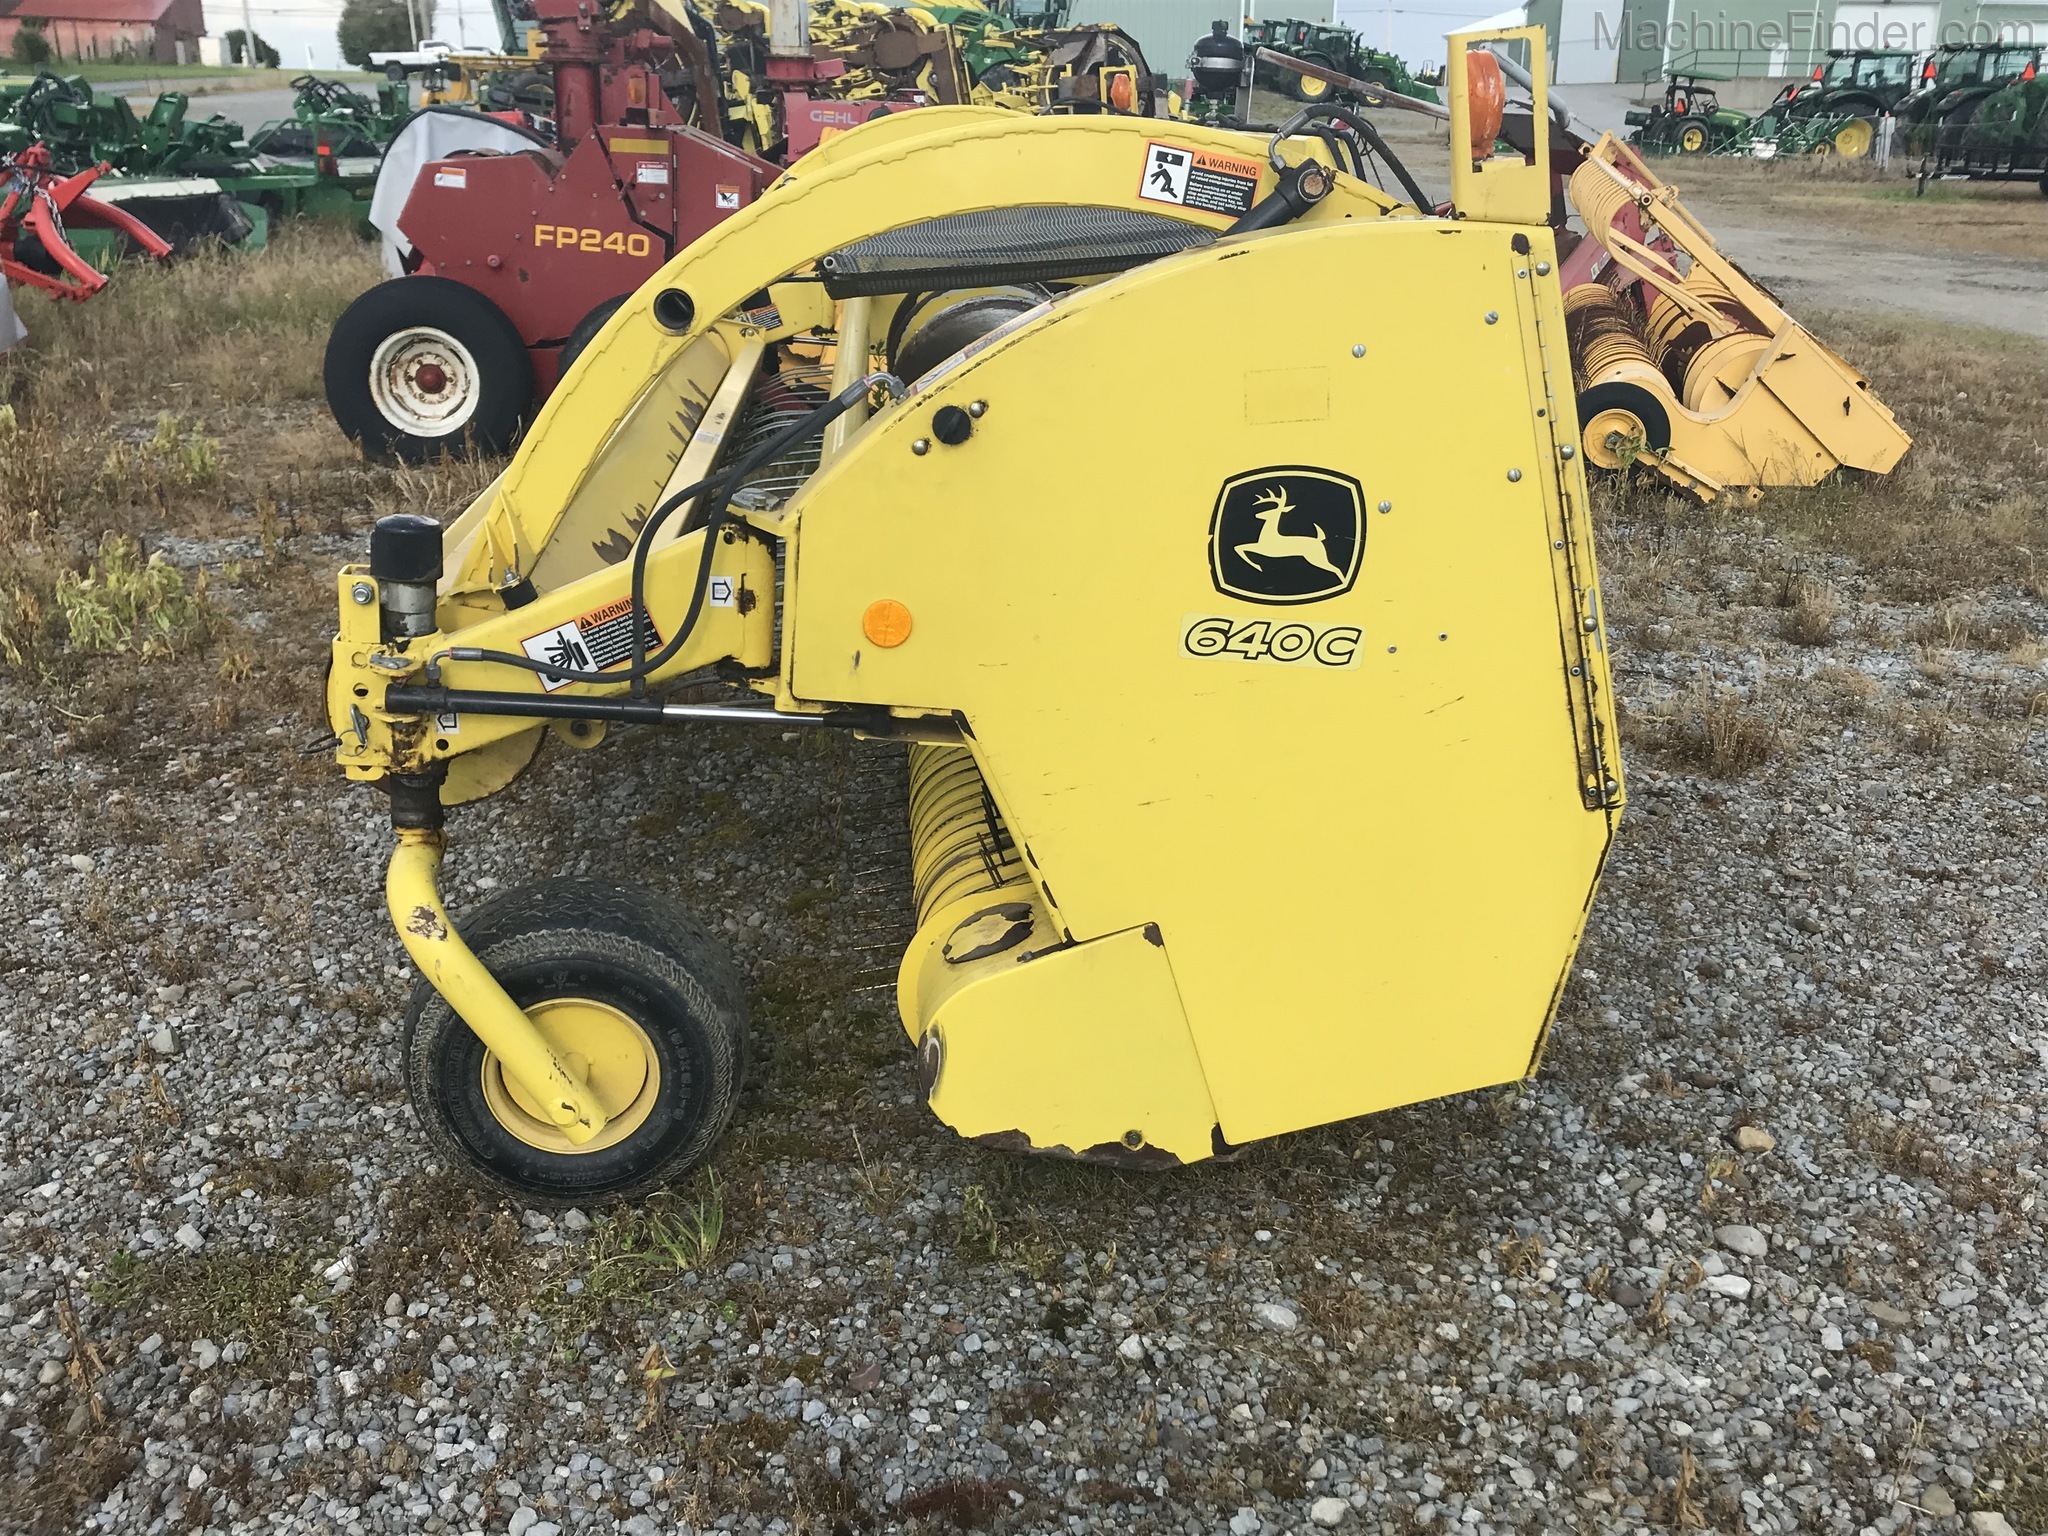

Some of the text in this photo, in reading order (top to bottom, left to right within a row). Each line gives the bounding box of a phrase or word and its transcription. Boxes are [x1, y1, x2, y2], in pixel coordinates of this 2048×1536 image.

[809, 110, 859, 125] GEHL
[1208, 158, 1257, 175] WARNING
[534, 224, 650, 258] FP240
[590, 598, 633, 623] WARNIN
[1184, 617, 1363, 667] 640C
